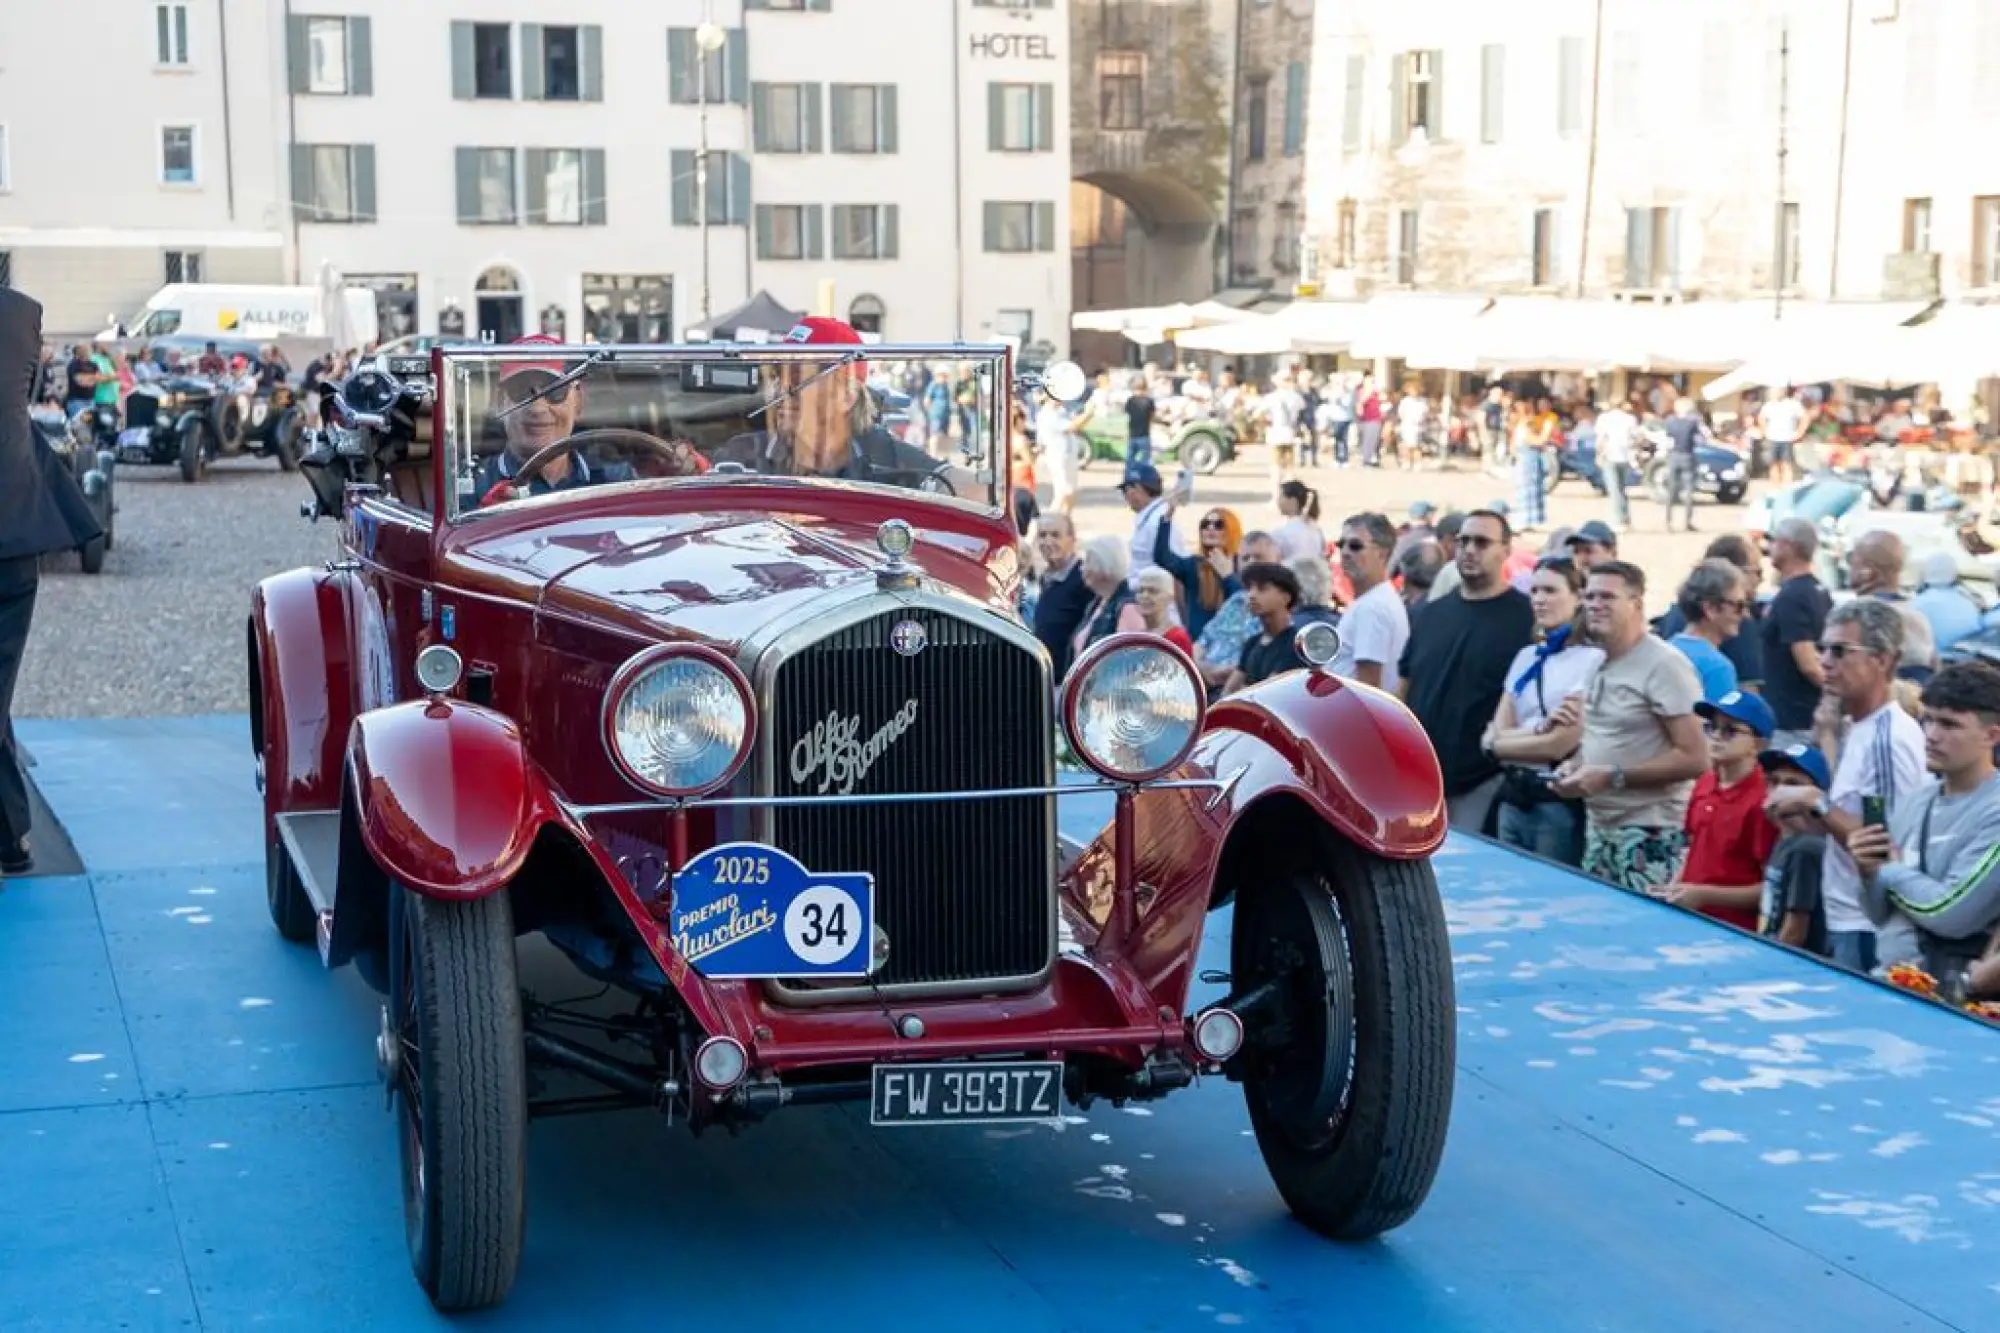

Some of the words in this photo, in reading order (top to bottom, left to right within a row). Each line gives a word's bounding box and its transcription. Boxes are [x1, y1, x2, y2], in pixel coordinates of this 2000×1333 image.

[970, 33, 1056, 59] HOTEL
[791, 710, 860, 794] Alfa
[832, 699, 919, 795] Romeo
[713, 856, 770, 885] 2025
[672, 899, 778, 961] Nuvolari
[679, 893, 739, 931] PREMIO
[801, 903, 848, 947] 34
[884, 1072, 931, 1116] FW
[942, 1071, 1052, 1114] 393TZ
